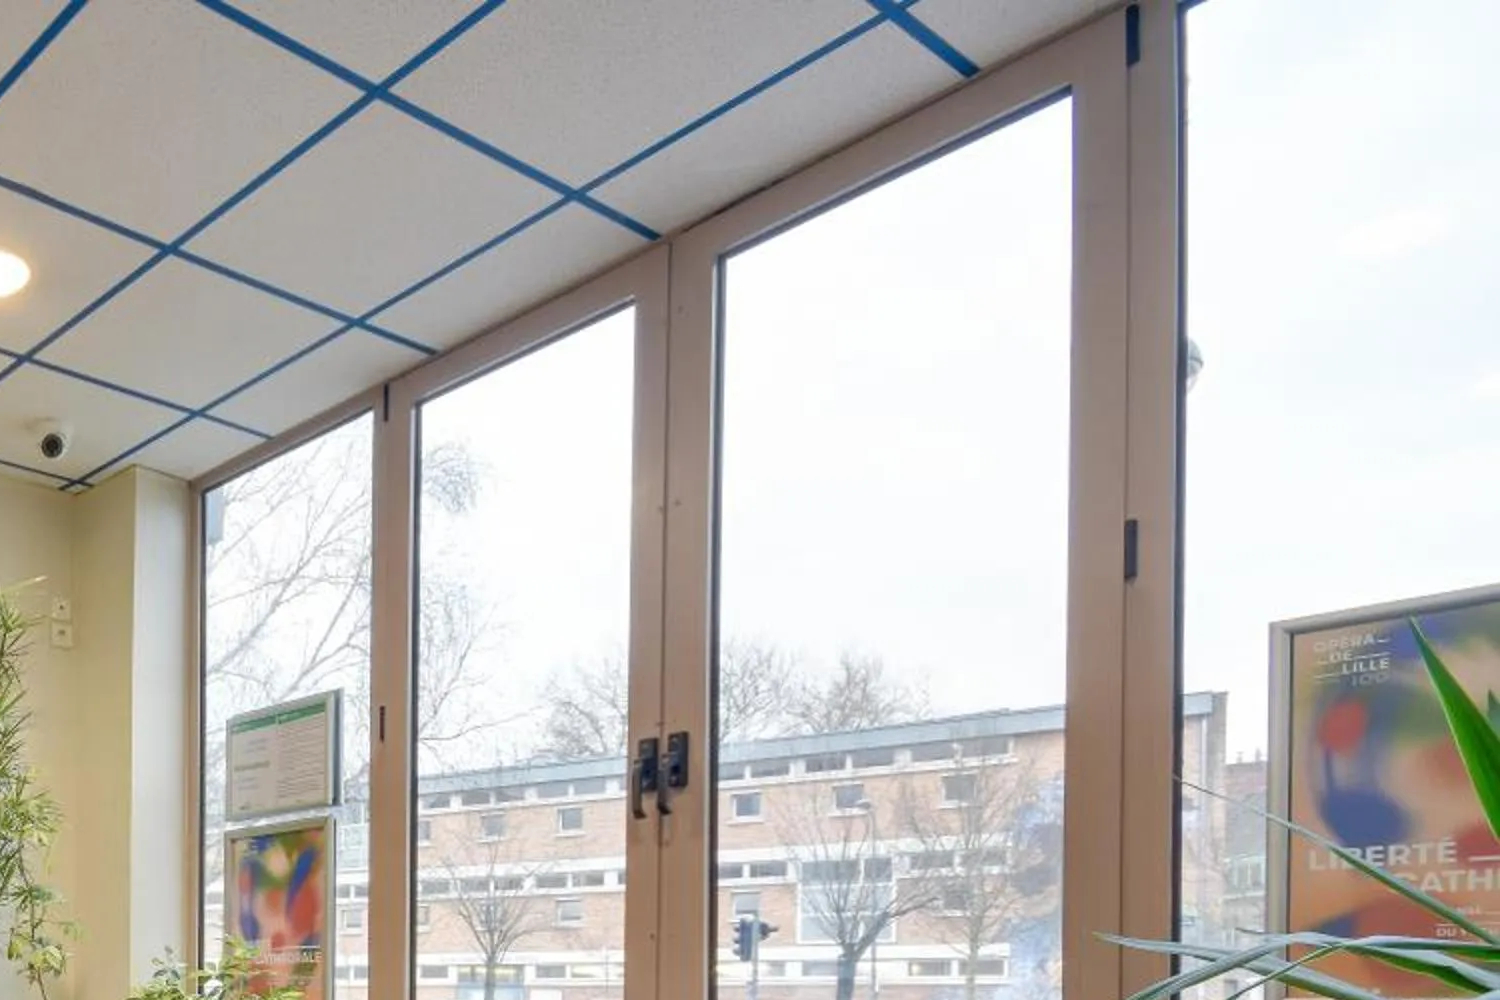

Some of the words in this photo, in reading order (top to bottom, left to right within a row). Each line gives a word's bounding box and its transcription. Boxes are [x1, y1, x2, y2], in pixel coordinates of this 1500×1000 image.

[1329, 650, 1353, 663] DE
[1341, 658, 1390, 675] LILLE
[1309, 837, 1457, 870] LIBERTÉ
[1392, 868, 1500, 893] ATH
